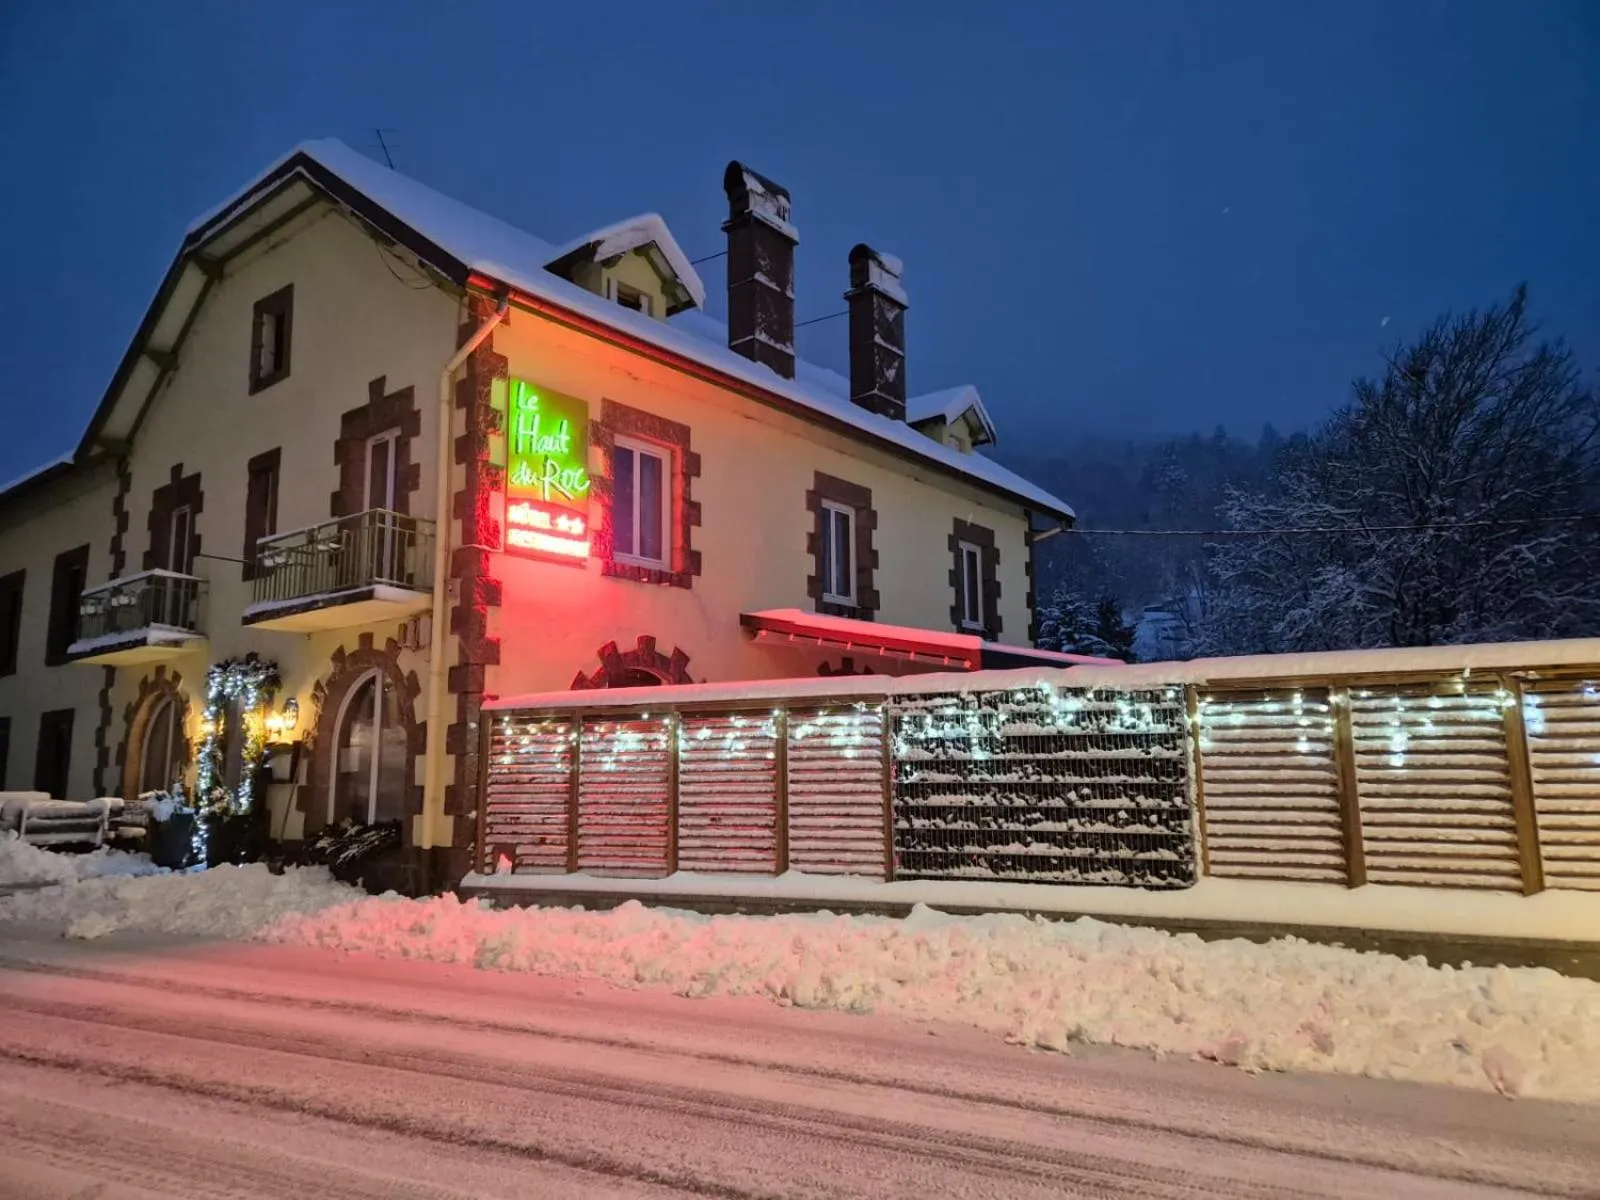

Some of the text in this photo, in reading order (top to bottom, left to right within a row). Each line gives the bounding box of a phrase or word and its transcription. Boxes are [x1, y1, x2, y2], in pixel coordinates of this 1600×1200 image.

[517, 381, 539, 410] Le
[516, 414, 571, 454] Haut
[511, 461, 538, 485] du
